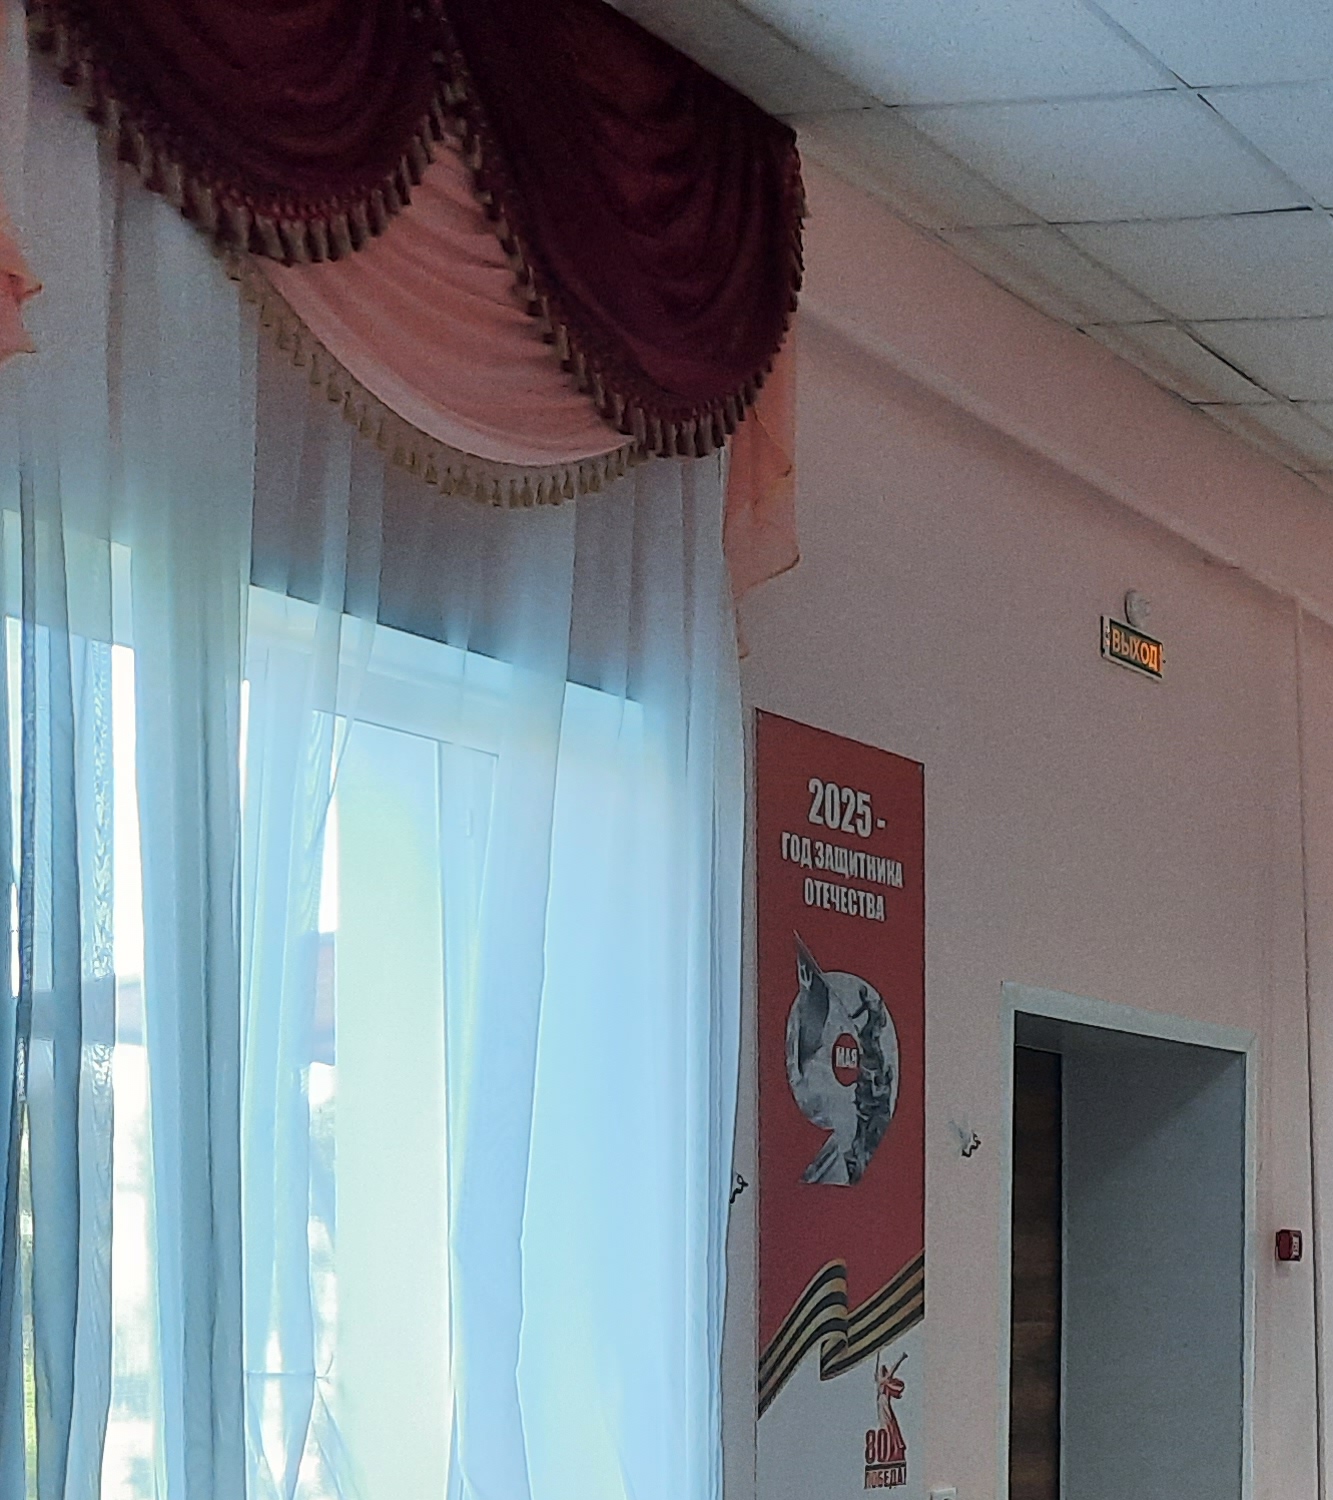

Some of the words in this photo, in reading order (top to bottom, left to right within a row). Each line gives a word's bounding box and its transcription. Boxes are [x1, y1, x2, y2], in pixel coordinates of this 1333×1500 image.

[1112, 628, 1159, 671] ВЫХОД
[781, 831, 813, 870] ГОД
[814, 841, 904, 889] ЗАЩИТНИКА
[804, 877, 886, 922] ОТЕЧЕСТВА
[835, 1045, 858, 1068] МАЯ
[864, 1428, 890, 1464] 80
